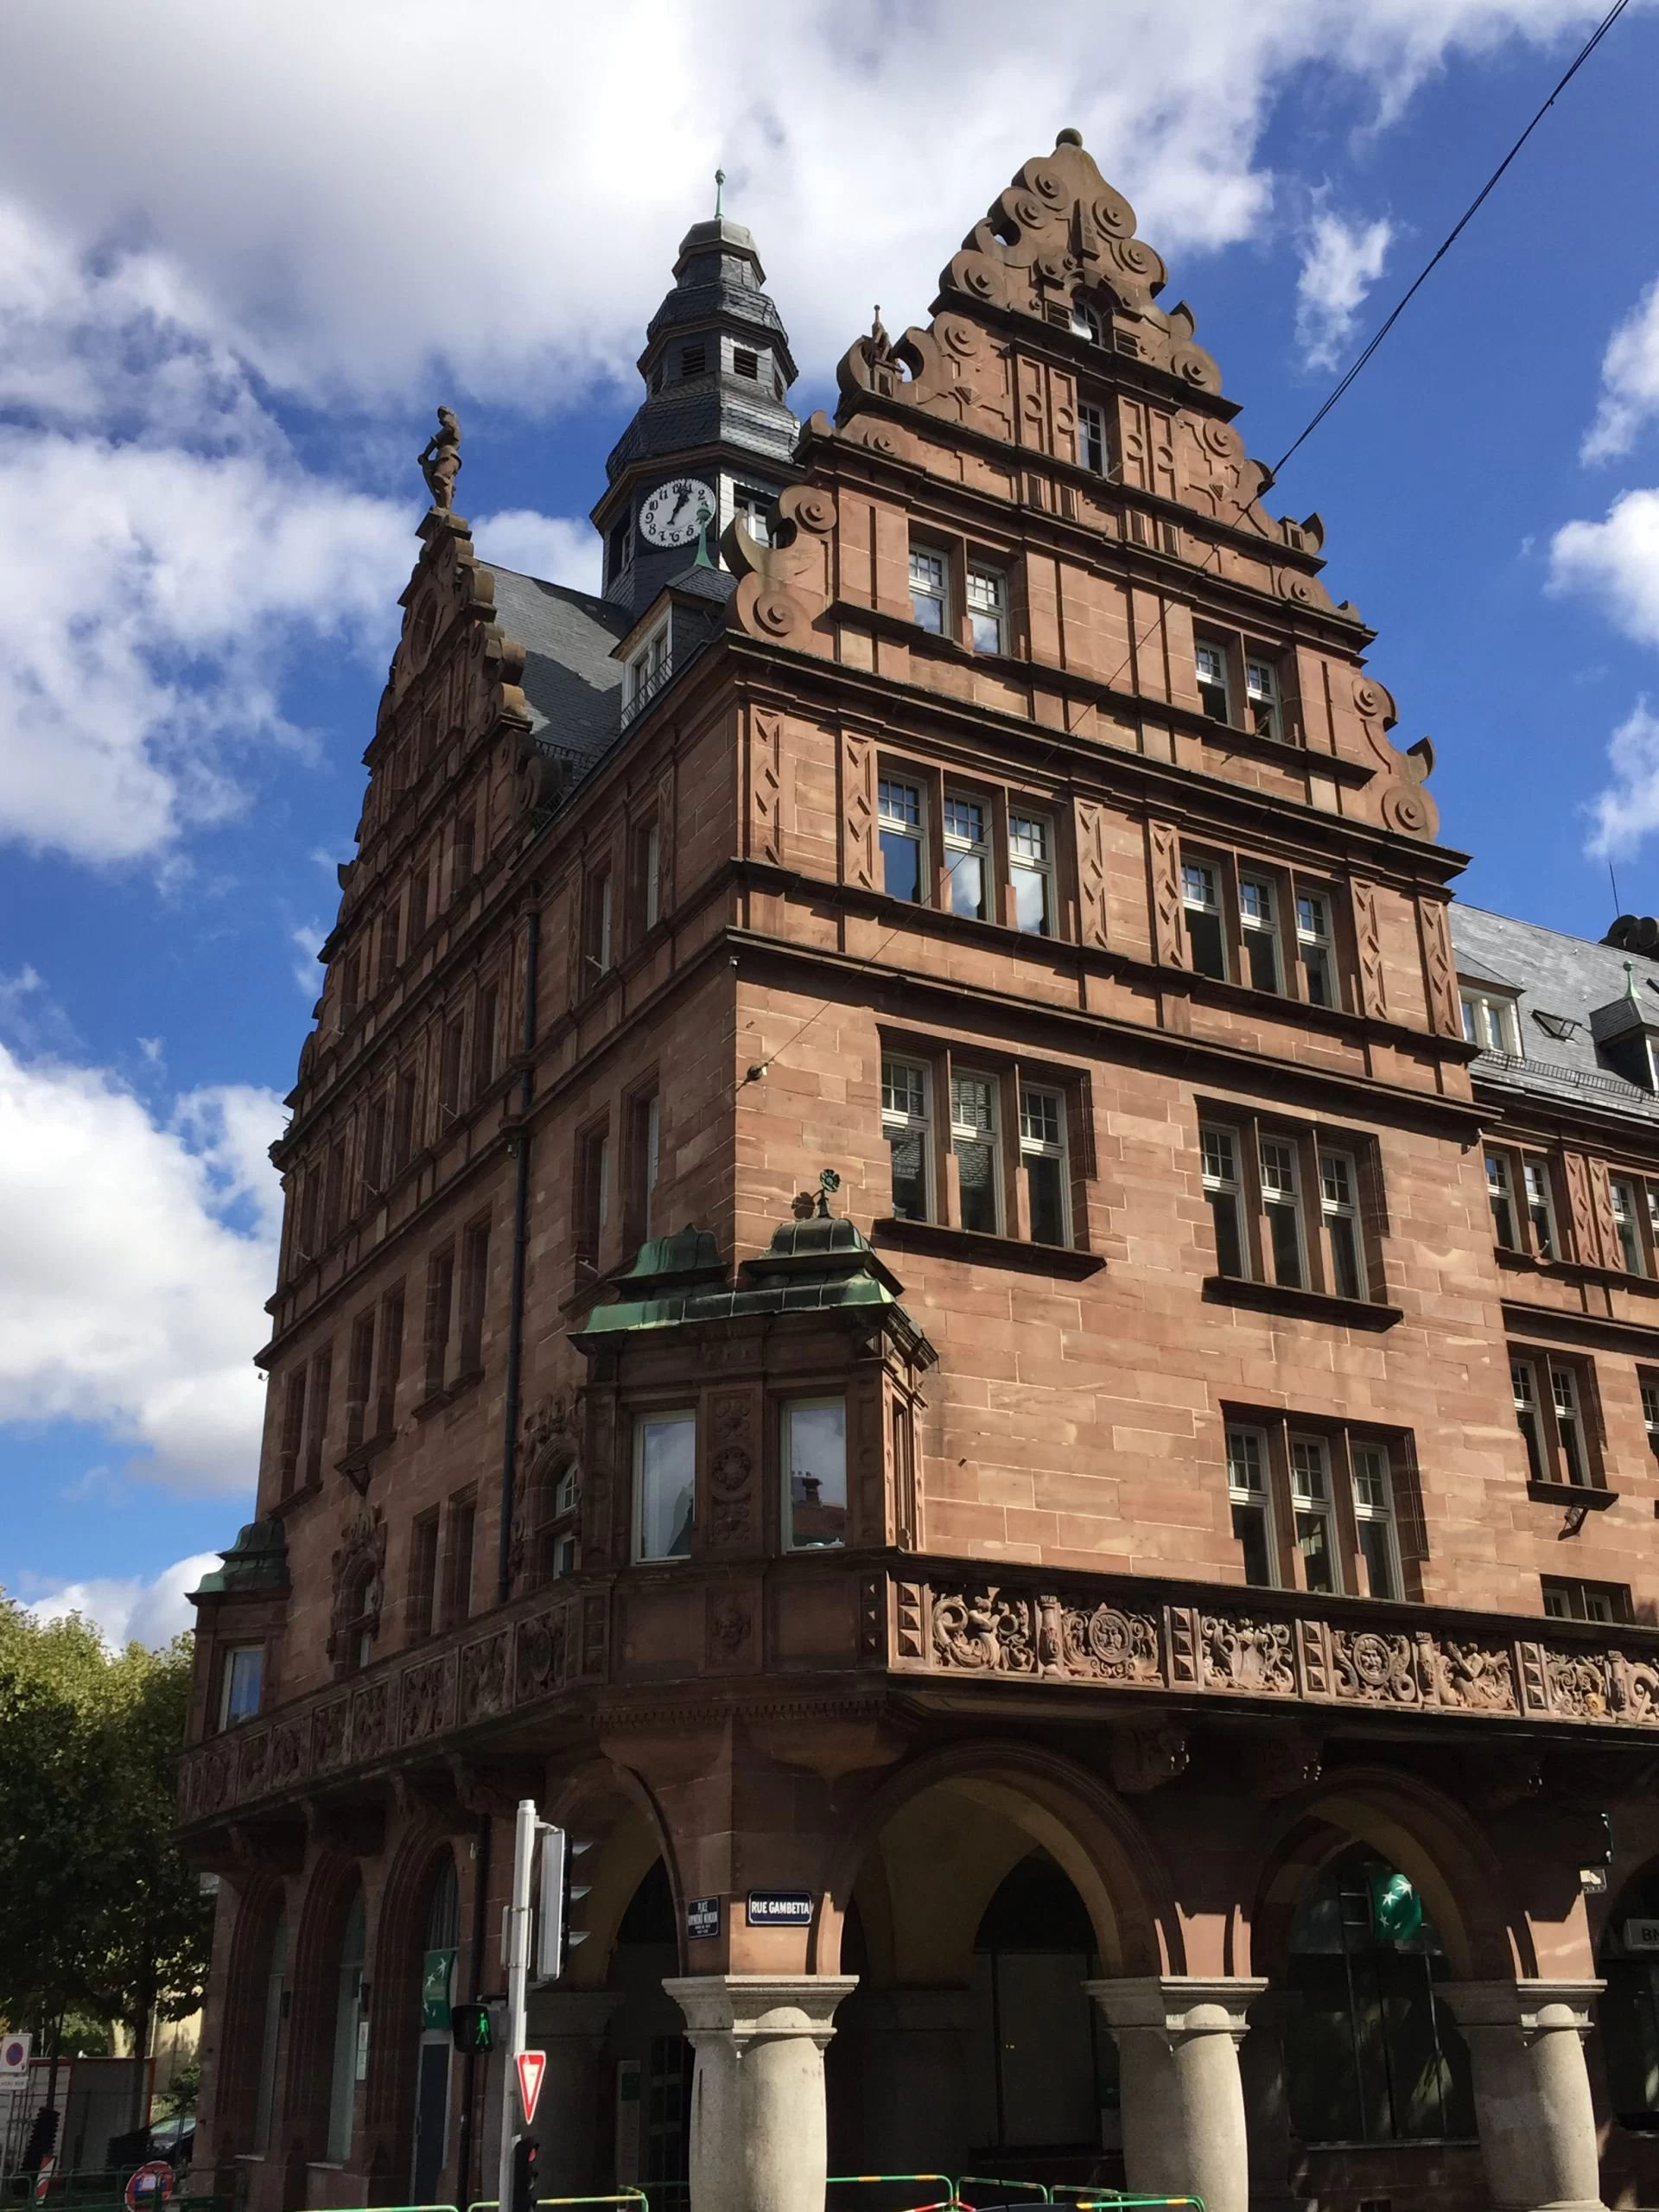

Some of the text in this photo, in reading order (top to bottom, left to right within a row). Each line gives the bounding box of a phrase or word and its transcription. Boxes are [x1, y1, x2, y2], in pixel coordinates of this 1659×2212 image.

[659, 490, 668, 500] 11
[698, 489, 706, 501] 2
[649, 499, 658, 511] 10
[645, 512, 654, 524] 9
[649, 524, 657, 536] 8
[670, 529, 683, 543] 6
[686, 524, 694, 536] 5
[658, 531, 666, 542] 7
[751, 1902, 810, 1915] RUE GAMBETTA
